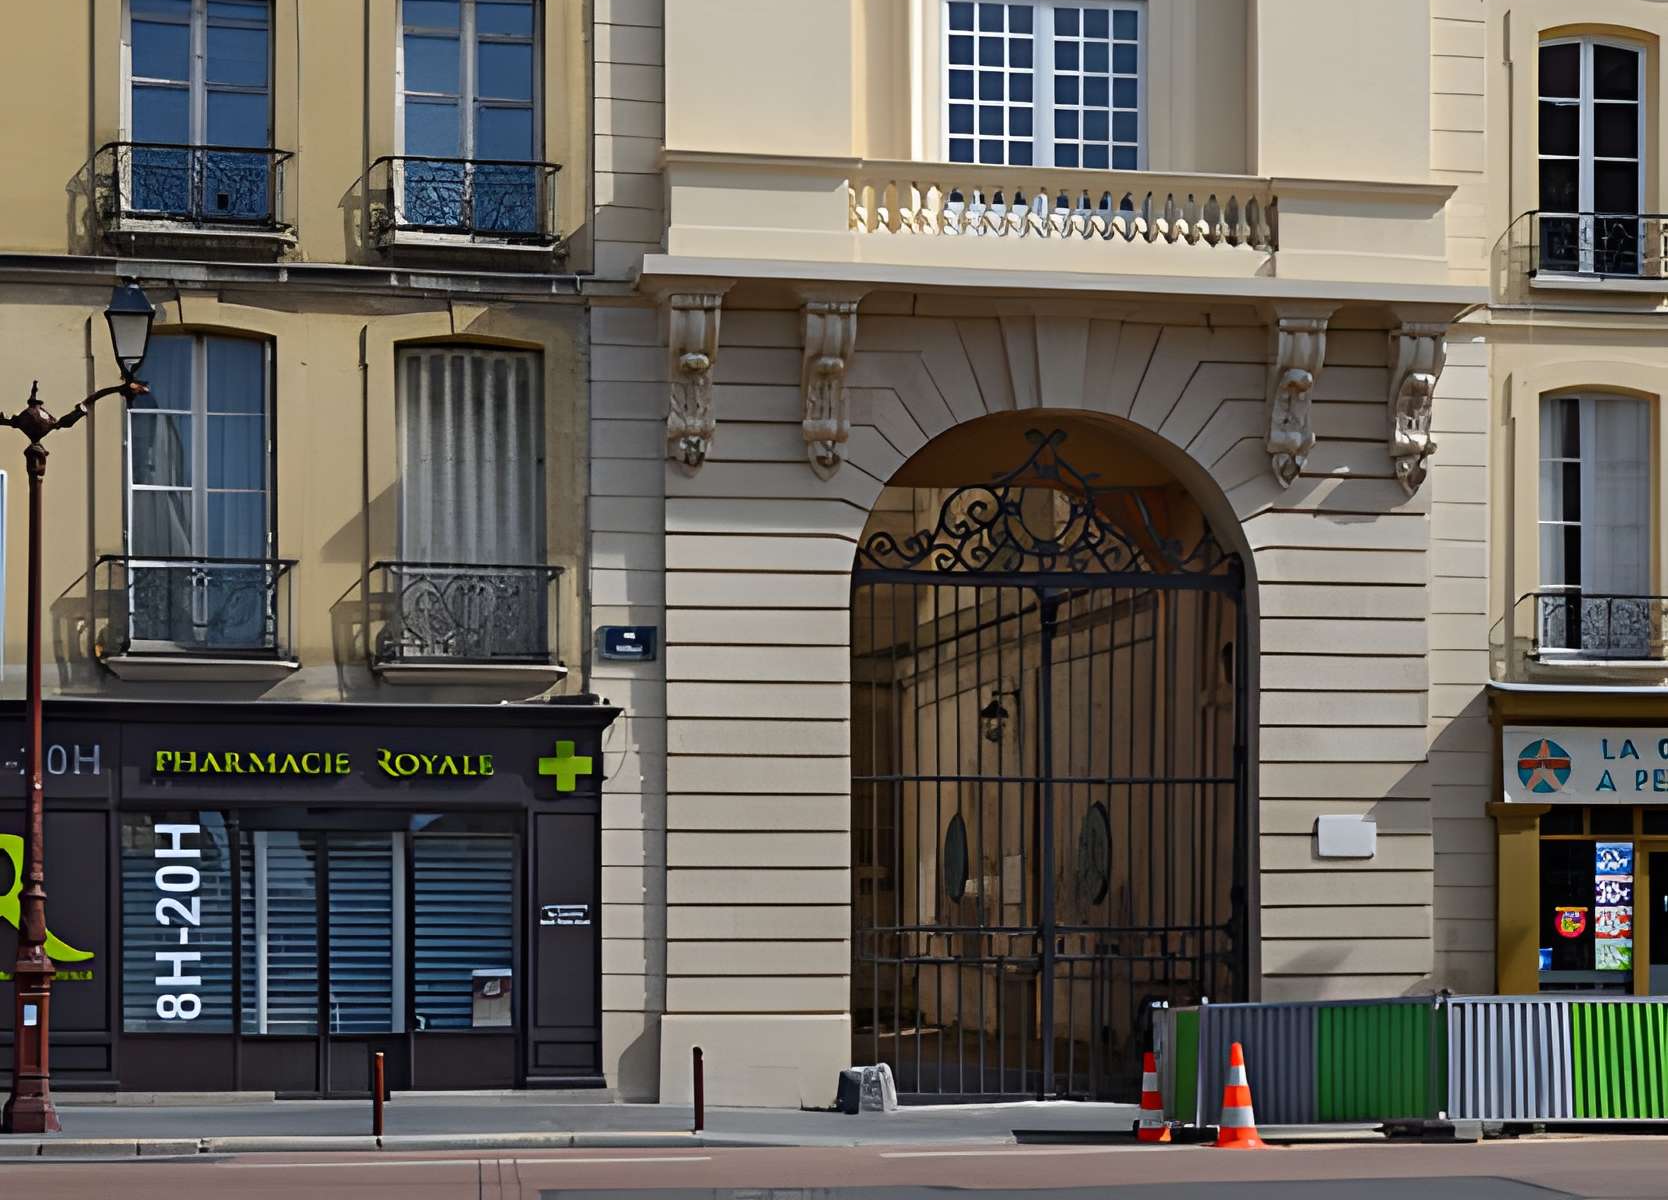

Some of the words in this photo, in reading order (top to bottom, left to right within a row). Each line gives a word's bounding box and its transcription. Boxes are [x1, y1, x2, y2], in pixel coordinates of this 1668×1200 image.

[1601, 738, 1640, 760] LA
[156, 750, 350, 774] PHARMACIE
[377, 748, 494, 777] ROYALE
[1595, 769, 1617, 792] A
[154, 824, 202, 1020] 8H-20H
